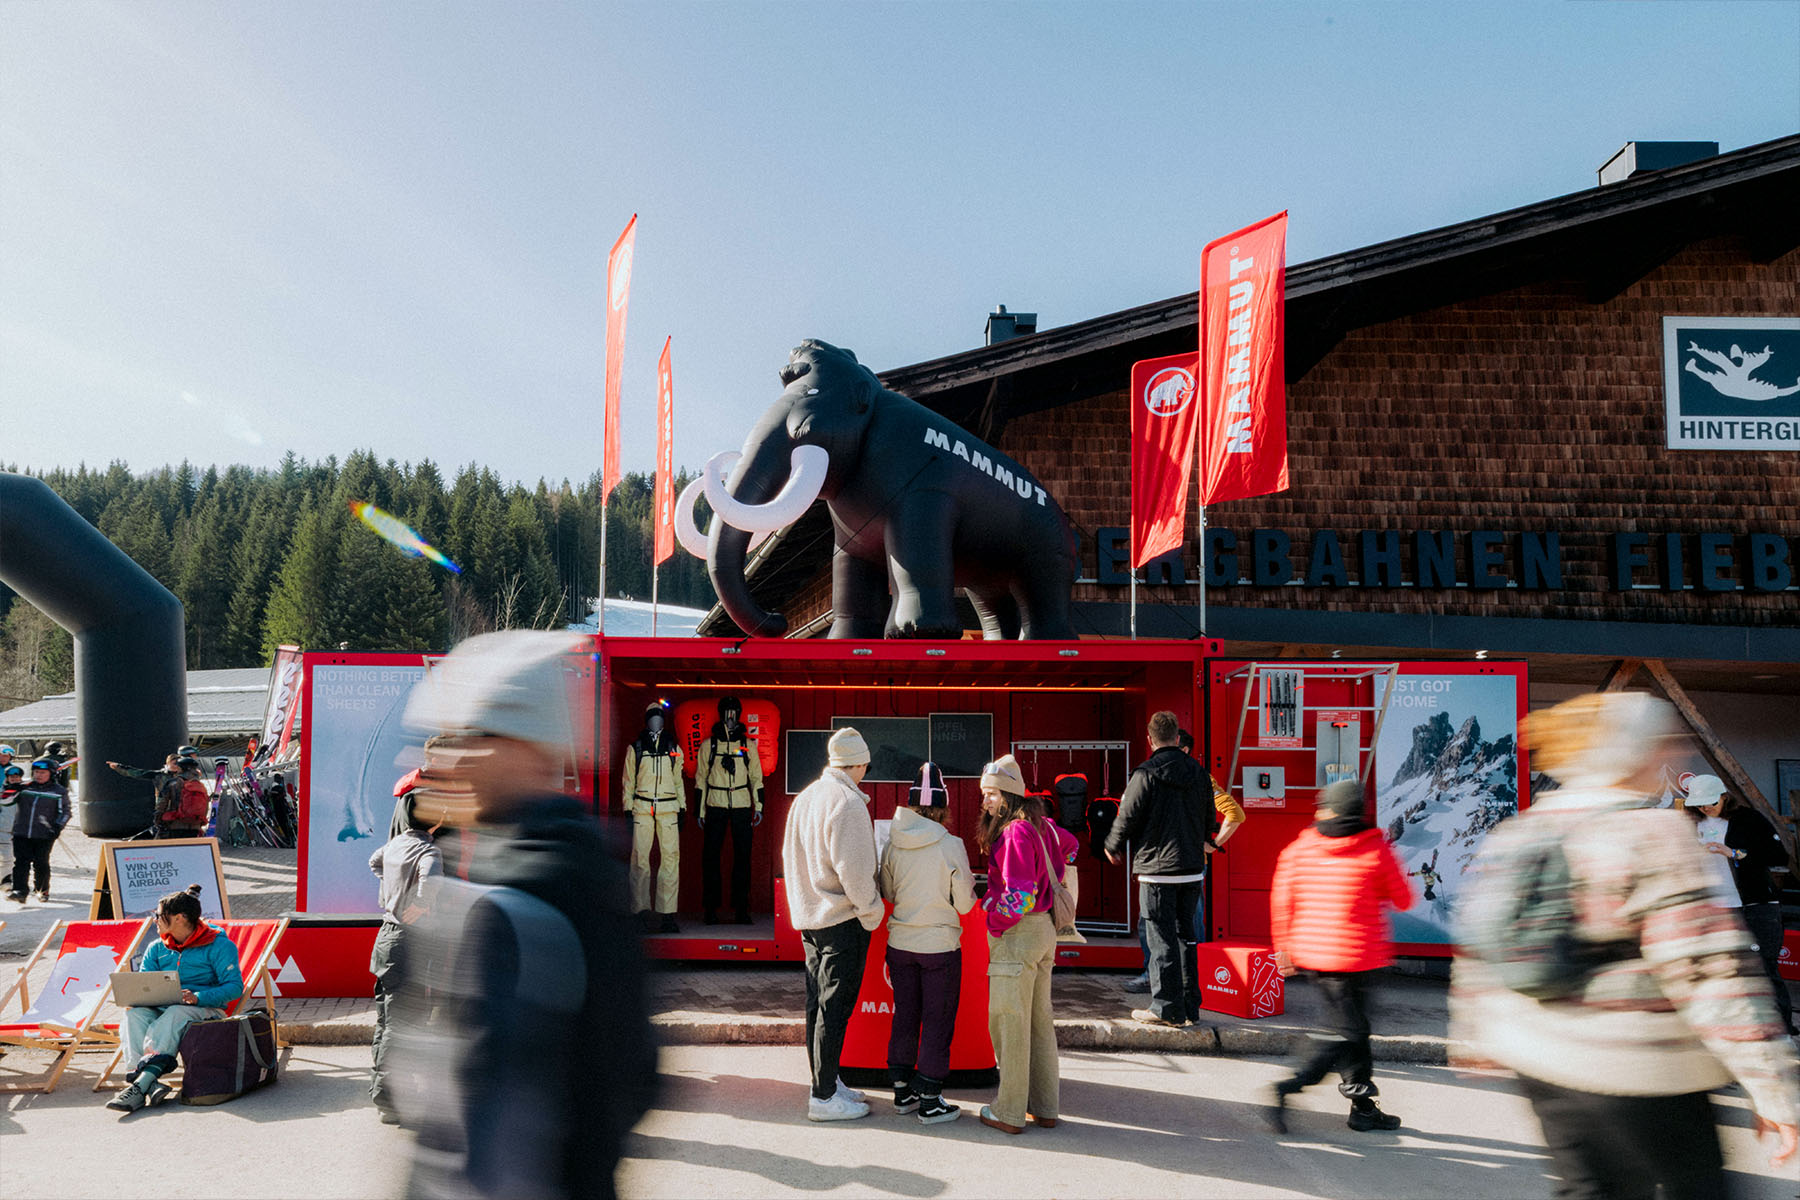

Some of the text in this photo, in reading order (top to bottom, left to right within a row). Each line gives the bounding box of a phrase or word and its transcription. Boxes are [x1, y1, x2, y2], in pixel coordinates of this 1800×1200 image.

[924, 427, 1047, 506] MAMMUT
[1073, 527, 1792, 591] EGBAHNEN FIEB
[318, 670, 377, 682] NOTHING
[318, 684, 400, 697] THAN CLEAN
[1421, 680, 1452, 692] GOT
[327, 699, 377, 710] SHEETS
[1392, 695, 1438, 708] HOME
[126, 861, 173, 871] WIN OUR
[127, 869, 180, 879] LIGHTEST
[128, 877, 170, 888] AIRBAG
[1207, 984, 1238, 995] MAMMUT
[861, 1001, 896, 1014] MA
